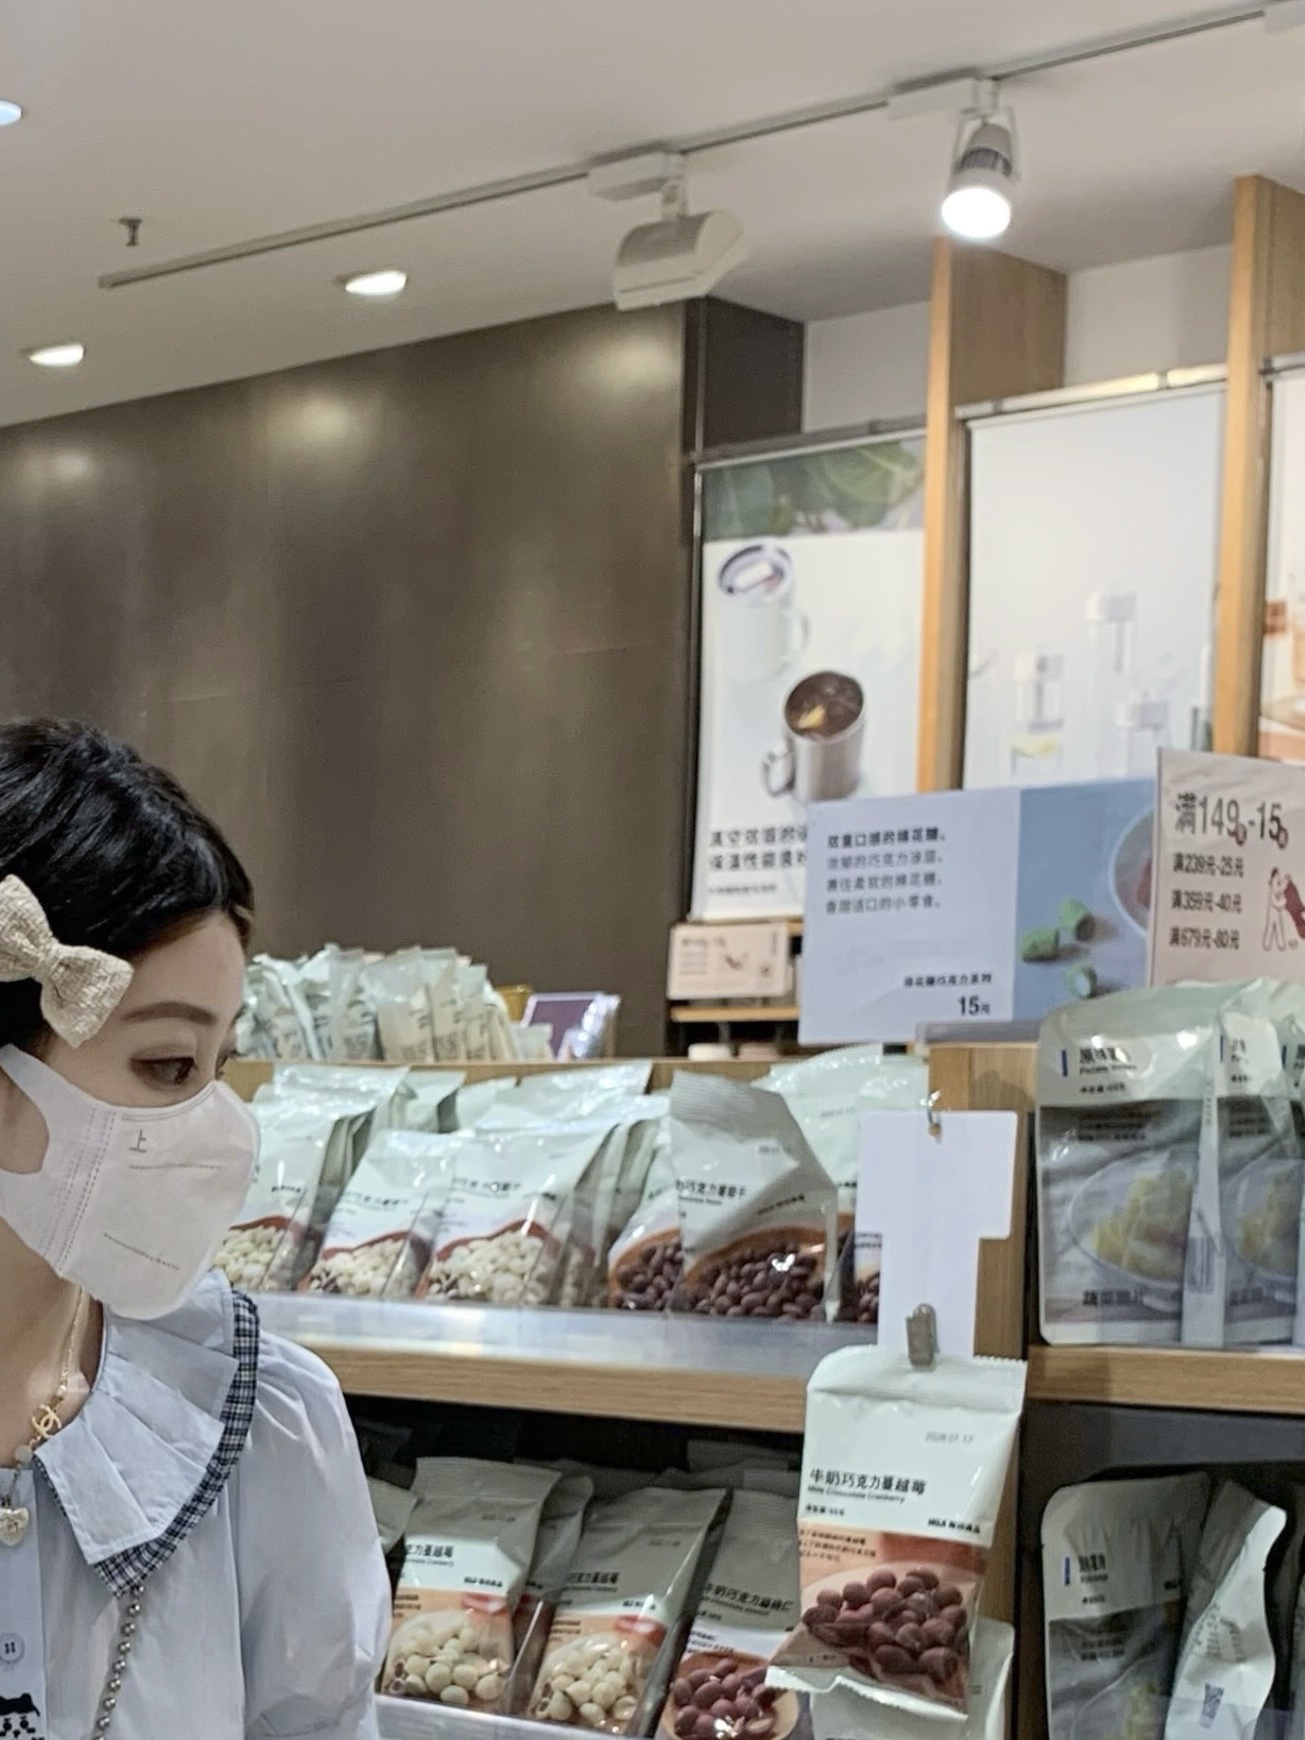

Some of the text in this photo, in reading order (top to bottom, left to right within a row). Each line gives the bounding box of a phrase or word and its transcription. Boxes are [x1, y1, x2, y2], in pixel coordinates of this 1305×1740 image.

[810, 1468, 926, 1495] 牛奶巧克力蔓越莓
